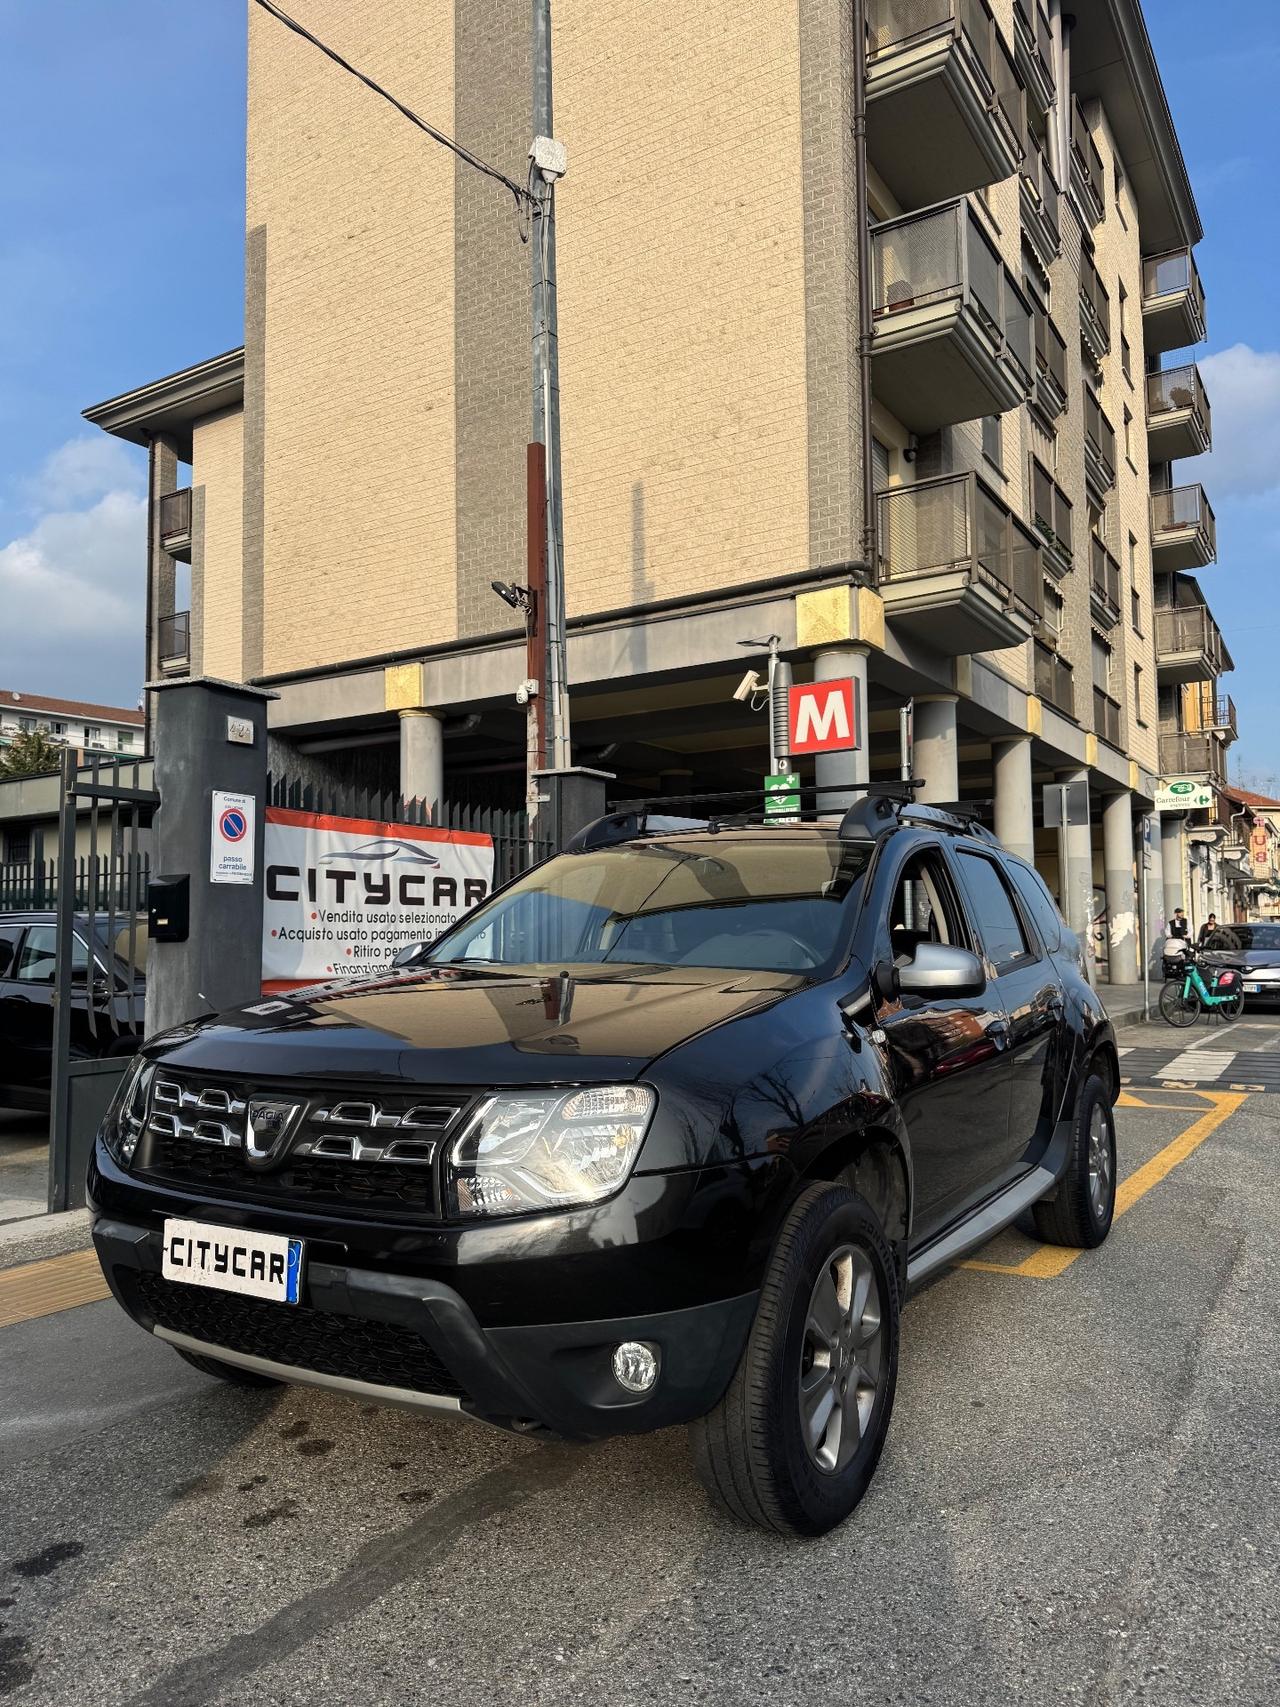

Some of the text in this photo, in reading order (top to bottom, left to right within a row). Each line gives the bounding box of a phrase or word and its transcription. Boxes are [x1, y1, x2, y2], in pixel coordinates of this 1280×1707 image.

[795, 690, 850, 744] M
[1156, 796, 1190, 804] Carrefour
[266, 865, 487, 906] CITYCAR
[318, 909, 457, 923] Vendita usato selezionato
[278, 927, 333, 942] Acquisto
[337, 927, 368, 940] usato
[371, 929, 431, 943] pagamento
[353, 945, 381, 957] Ritiro
[252, 1109, 284, 1122] DACIA
[170, 1237, 285, 1284] CITYCAR
